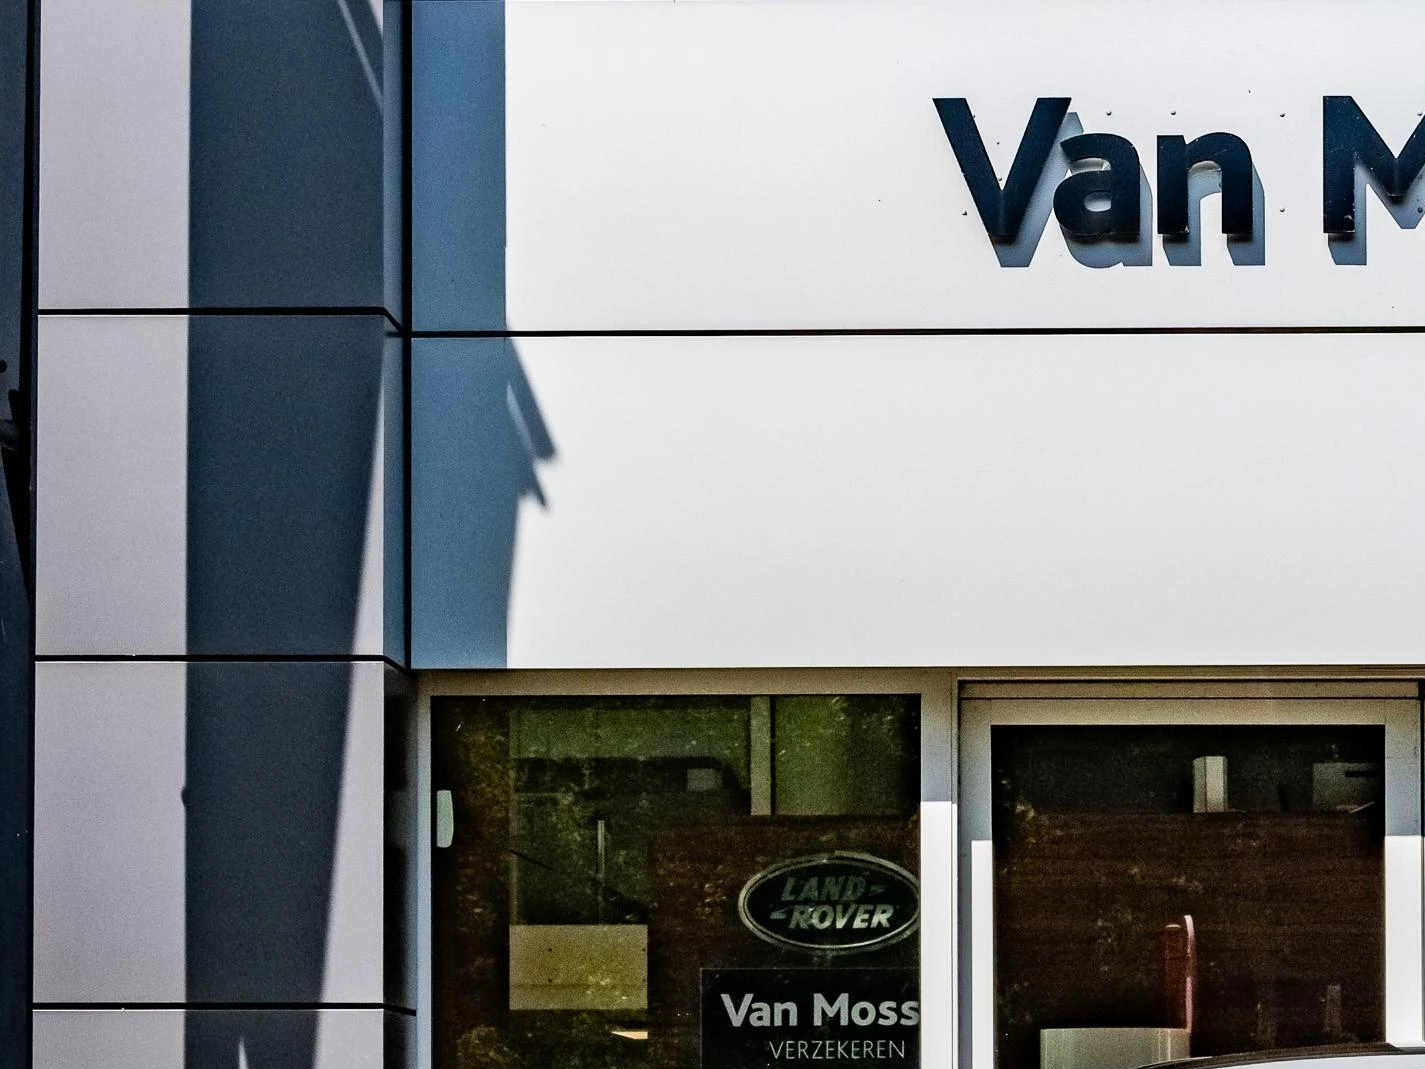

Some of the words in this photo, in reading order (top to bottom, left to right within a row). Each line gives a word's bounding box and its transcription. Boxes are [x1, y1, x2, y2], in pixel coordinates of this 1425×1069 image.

[931, 96, 1256, 236] Van
[781, 875, 867, 902] LAND
[788, 903, 895, 930] ROVER
[720, 993, 798, 1027] Van
[812, 992, 920, 1027] Moss
[769, 1039, 905, 1060] VERZEKEREN
